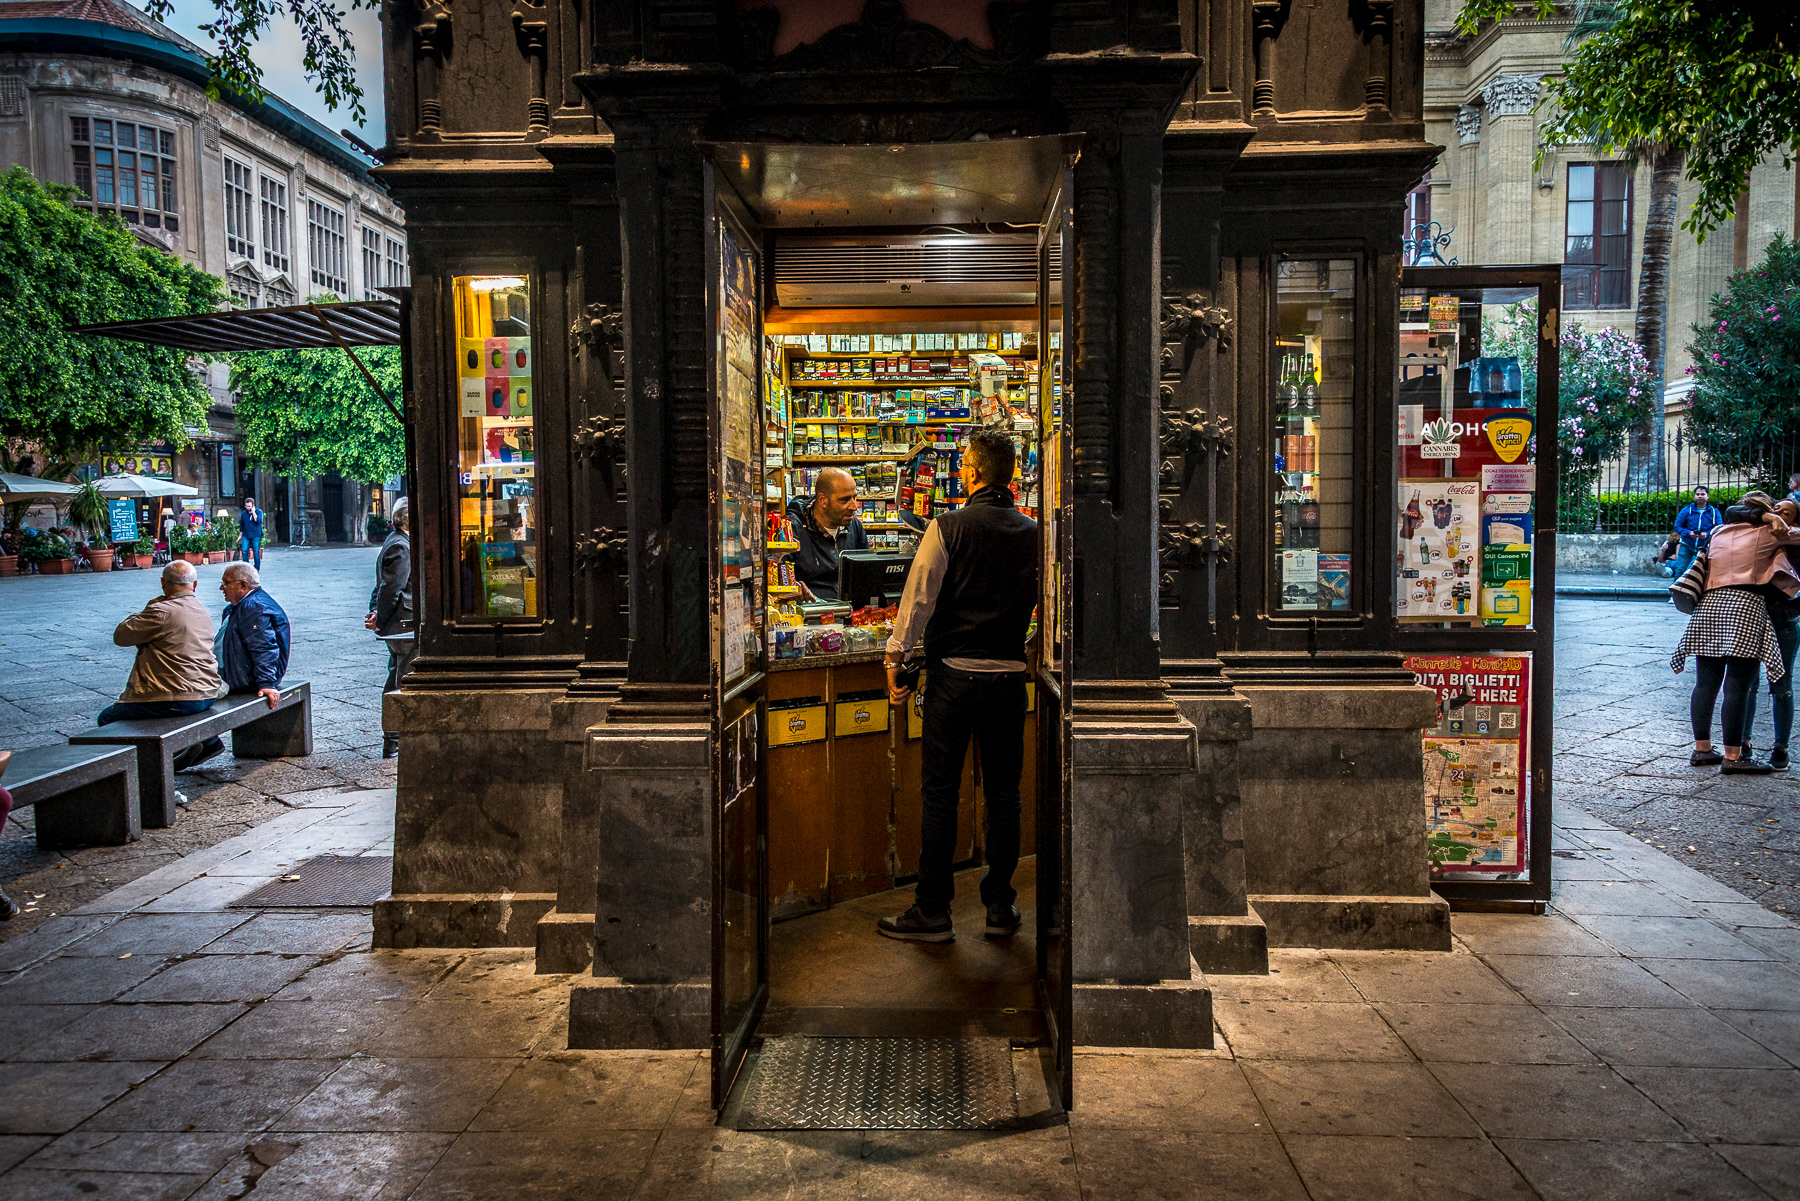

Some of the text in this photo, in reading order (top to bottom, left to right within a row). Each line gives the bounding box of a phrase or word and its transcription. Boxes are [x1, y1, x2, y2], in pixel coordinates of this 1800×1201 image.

[885, 564, 905, 573] msi
[1410, 657, 1462, 670] Monreale
[1472, 657, 1522, 671] Mondello
[1413, 672, 1521, 687] DITA BIGLIETTI
[1480, 688, 1517, 703] HERE
[1450, 769, 1465, 782] 24
